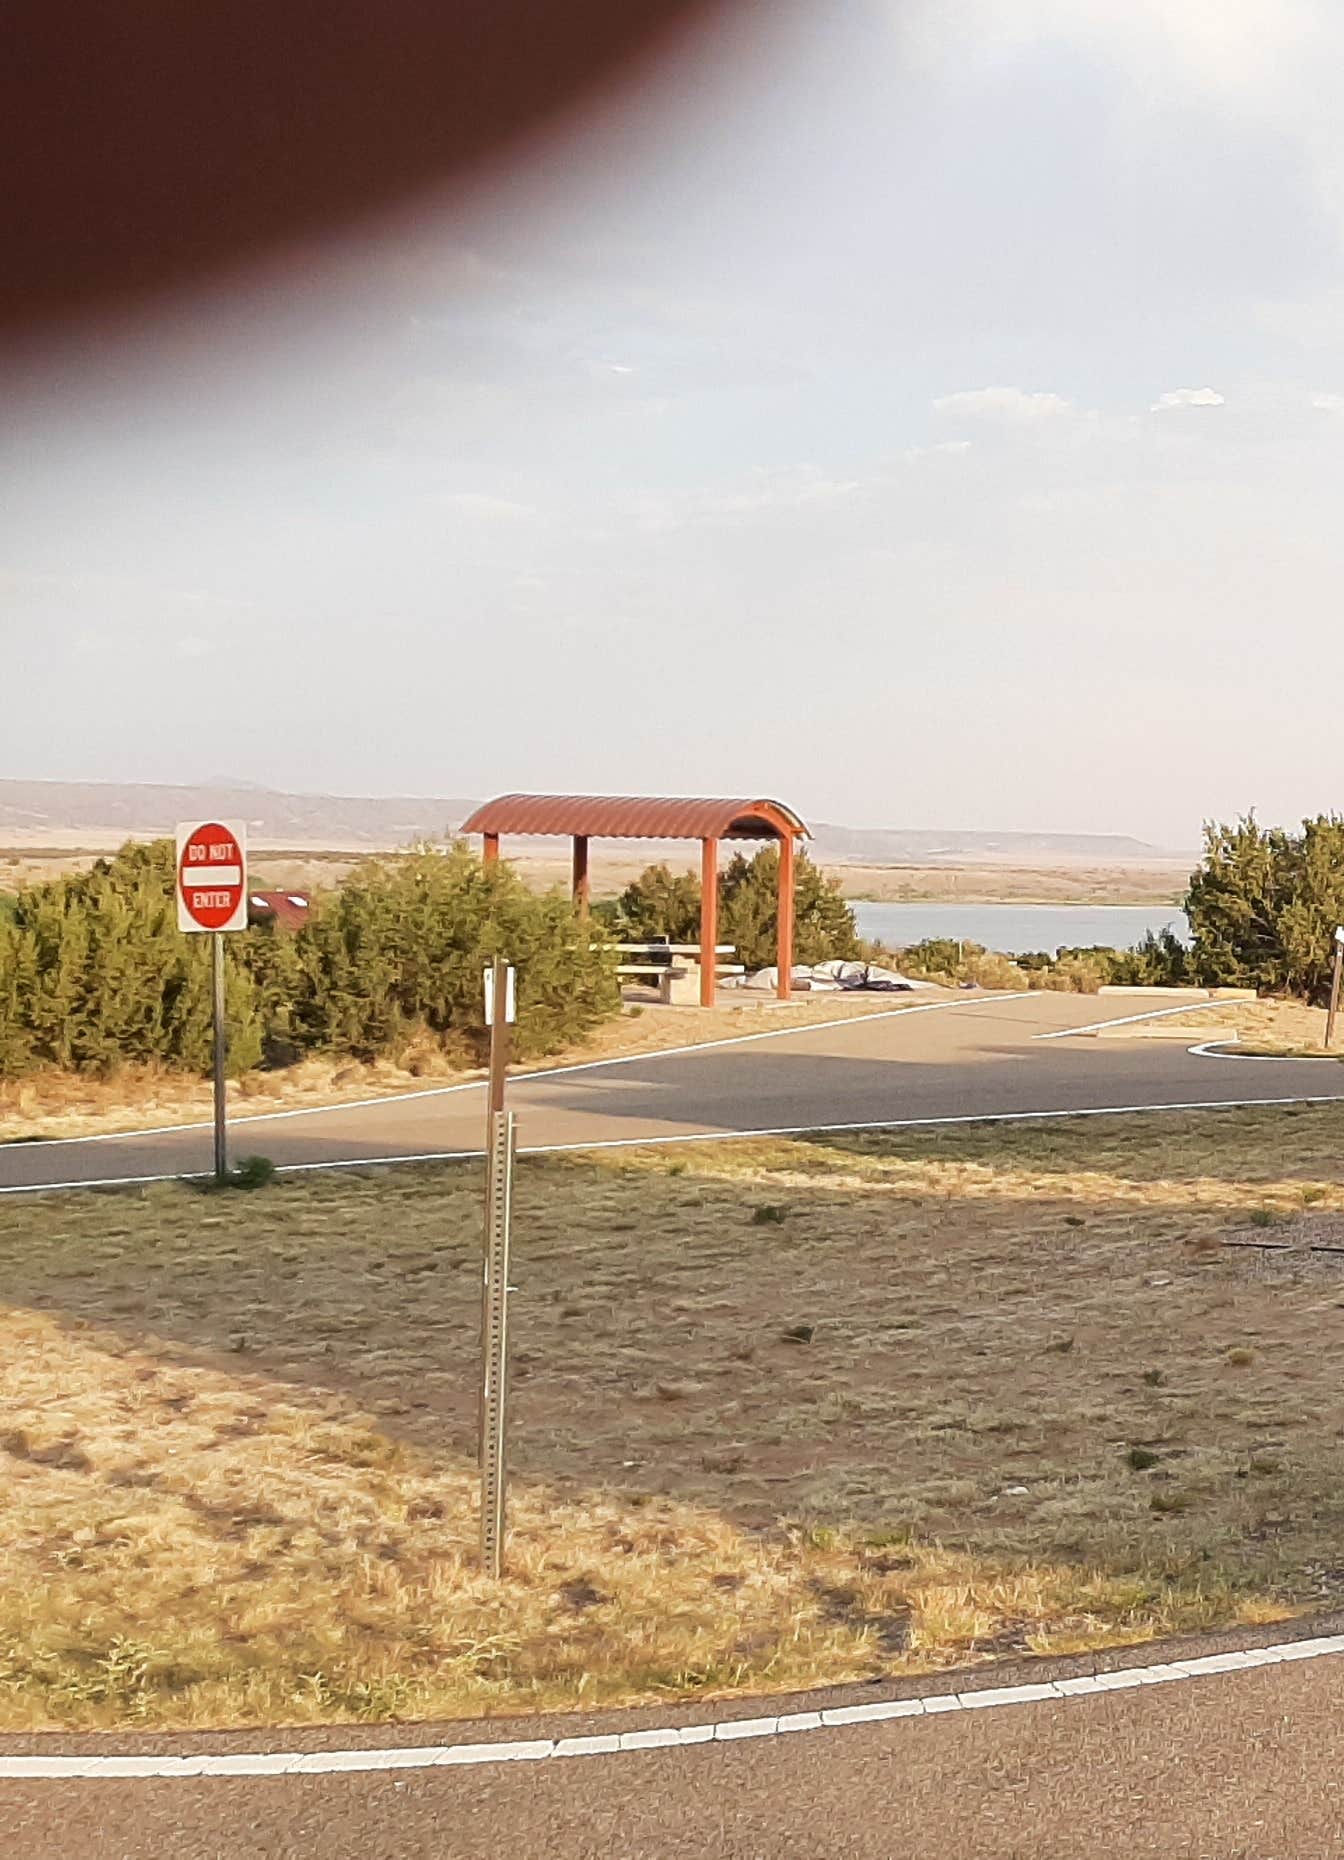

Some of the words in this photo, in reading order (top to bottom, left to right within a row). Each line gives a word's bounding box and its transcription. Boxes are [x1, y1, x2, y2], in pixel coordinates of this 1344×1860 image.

[188, 844, 206, 861] DO
[209, 843, 234, 860] NOT
[192, 891, 232, 909] ENTER
